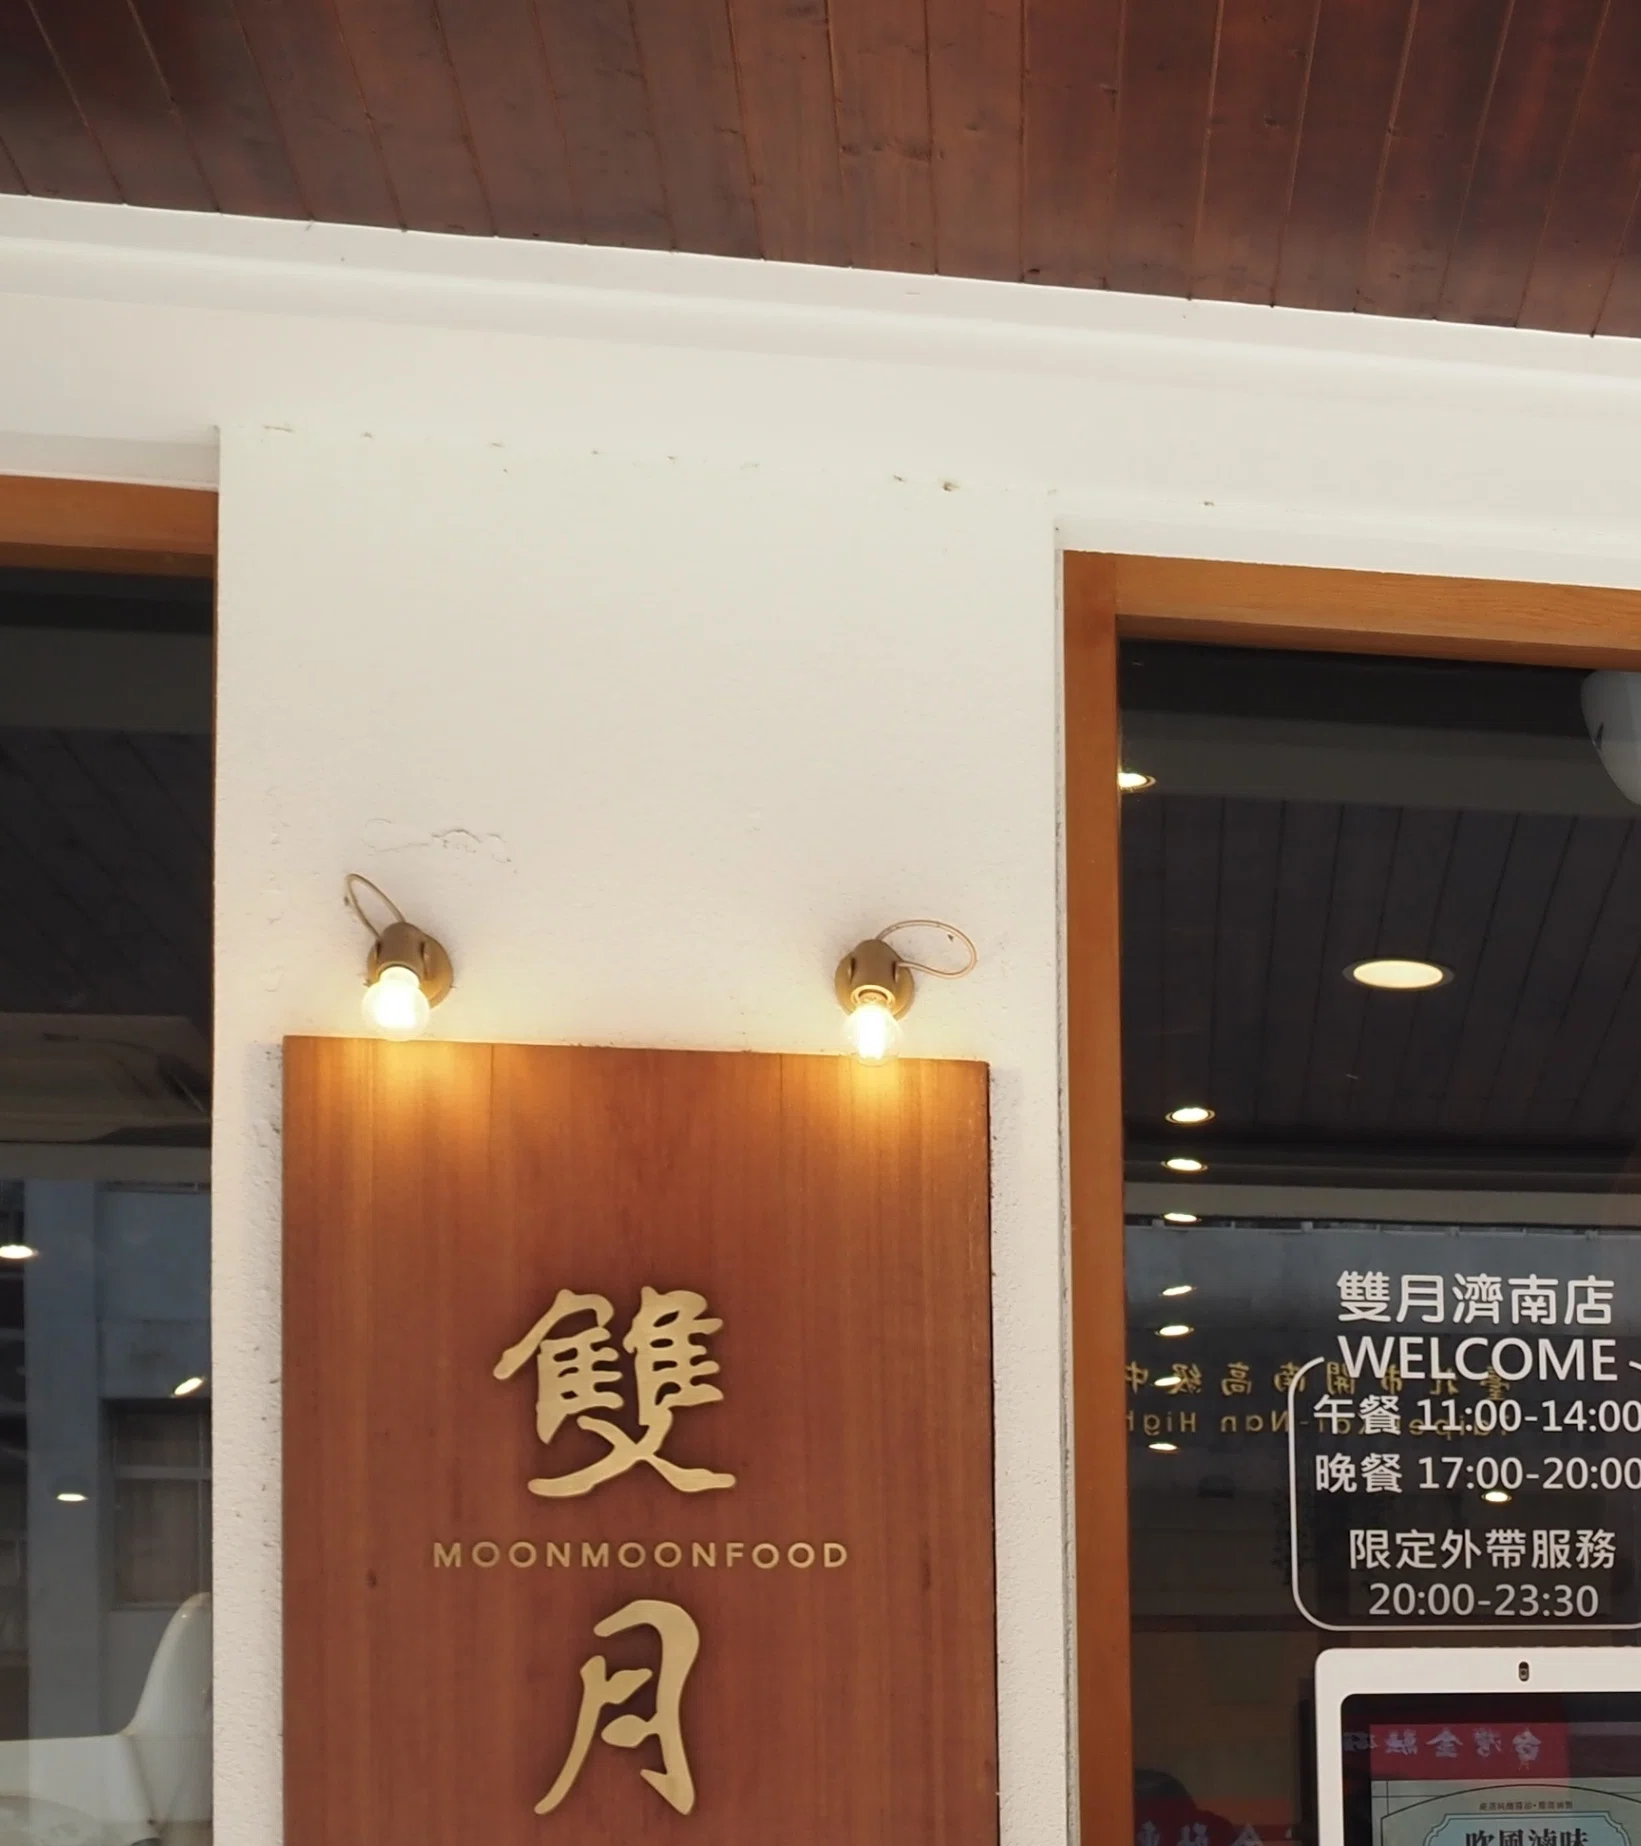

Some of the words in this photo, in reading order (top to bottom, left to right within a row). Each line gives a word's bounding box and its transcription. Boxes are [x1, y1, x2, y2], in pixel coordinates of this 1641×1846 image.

[1336, 1271, 1615, 1325] 雙月濟南店
[1338, 1336, 1618, 1381] WELCOME
[492, 1285, 736, 1498] 雙
[1313, 1395, 1401, 1435] 午餐
[1315, 1452, 1402, 1494] 晚餐
[433, 1541, 849, 1569] MOONMOONFOOD
[1350, 1529, 1616, 1570] 限定外帶服務
[1369, 1583, 1600, 1619] 20:00-23:30
[534, 1598, 700, 1816] 月
